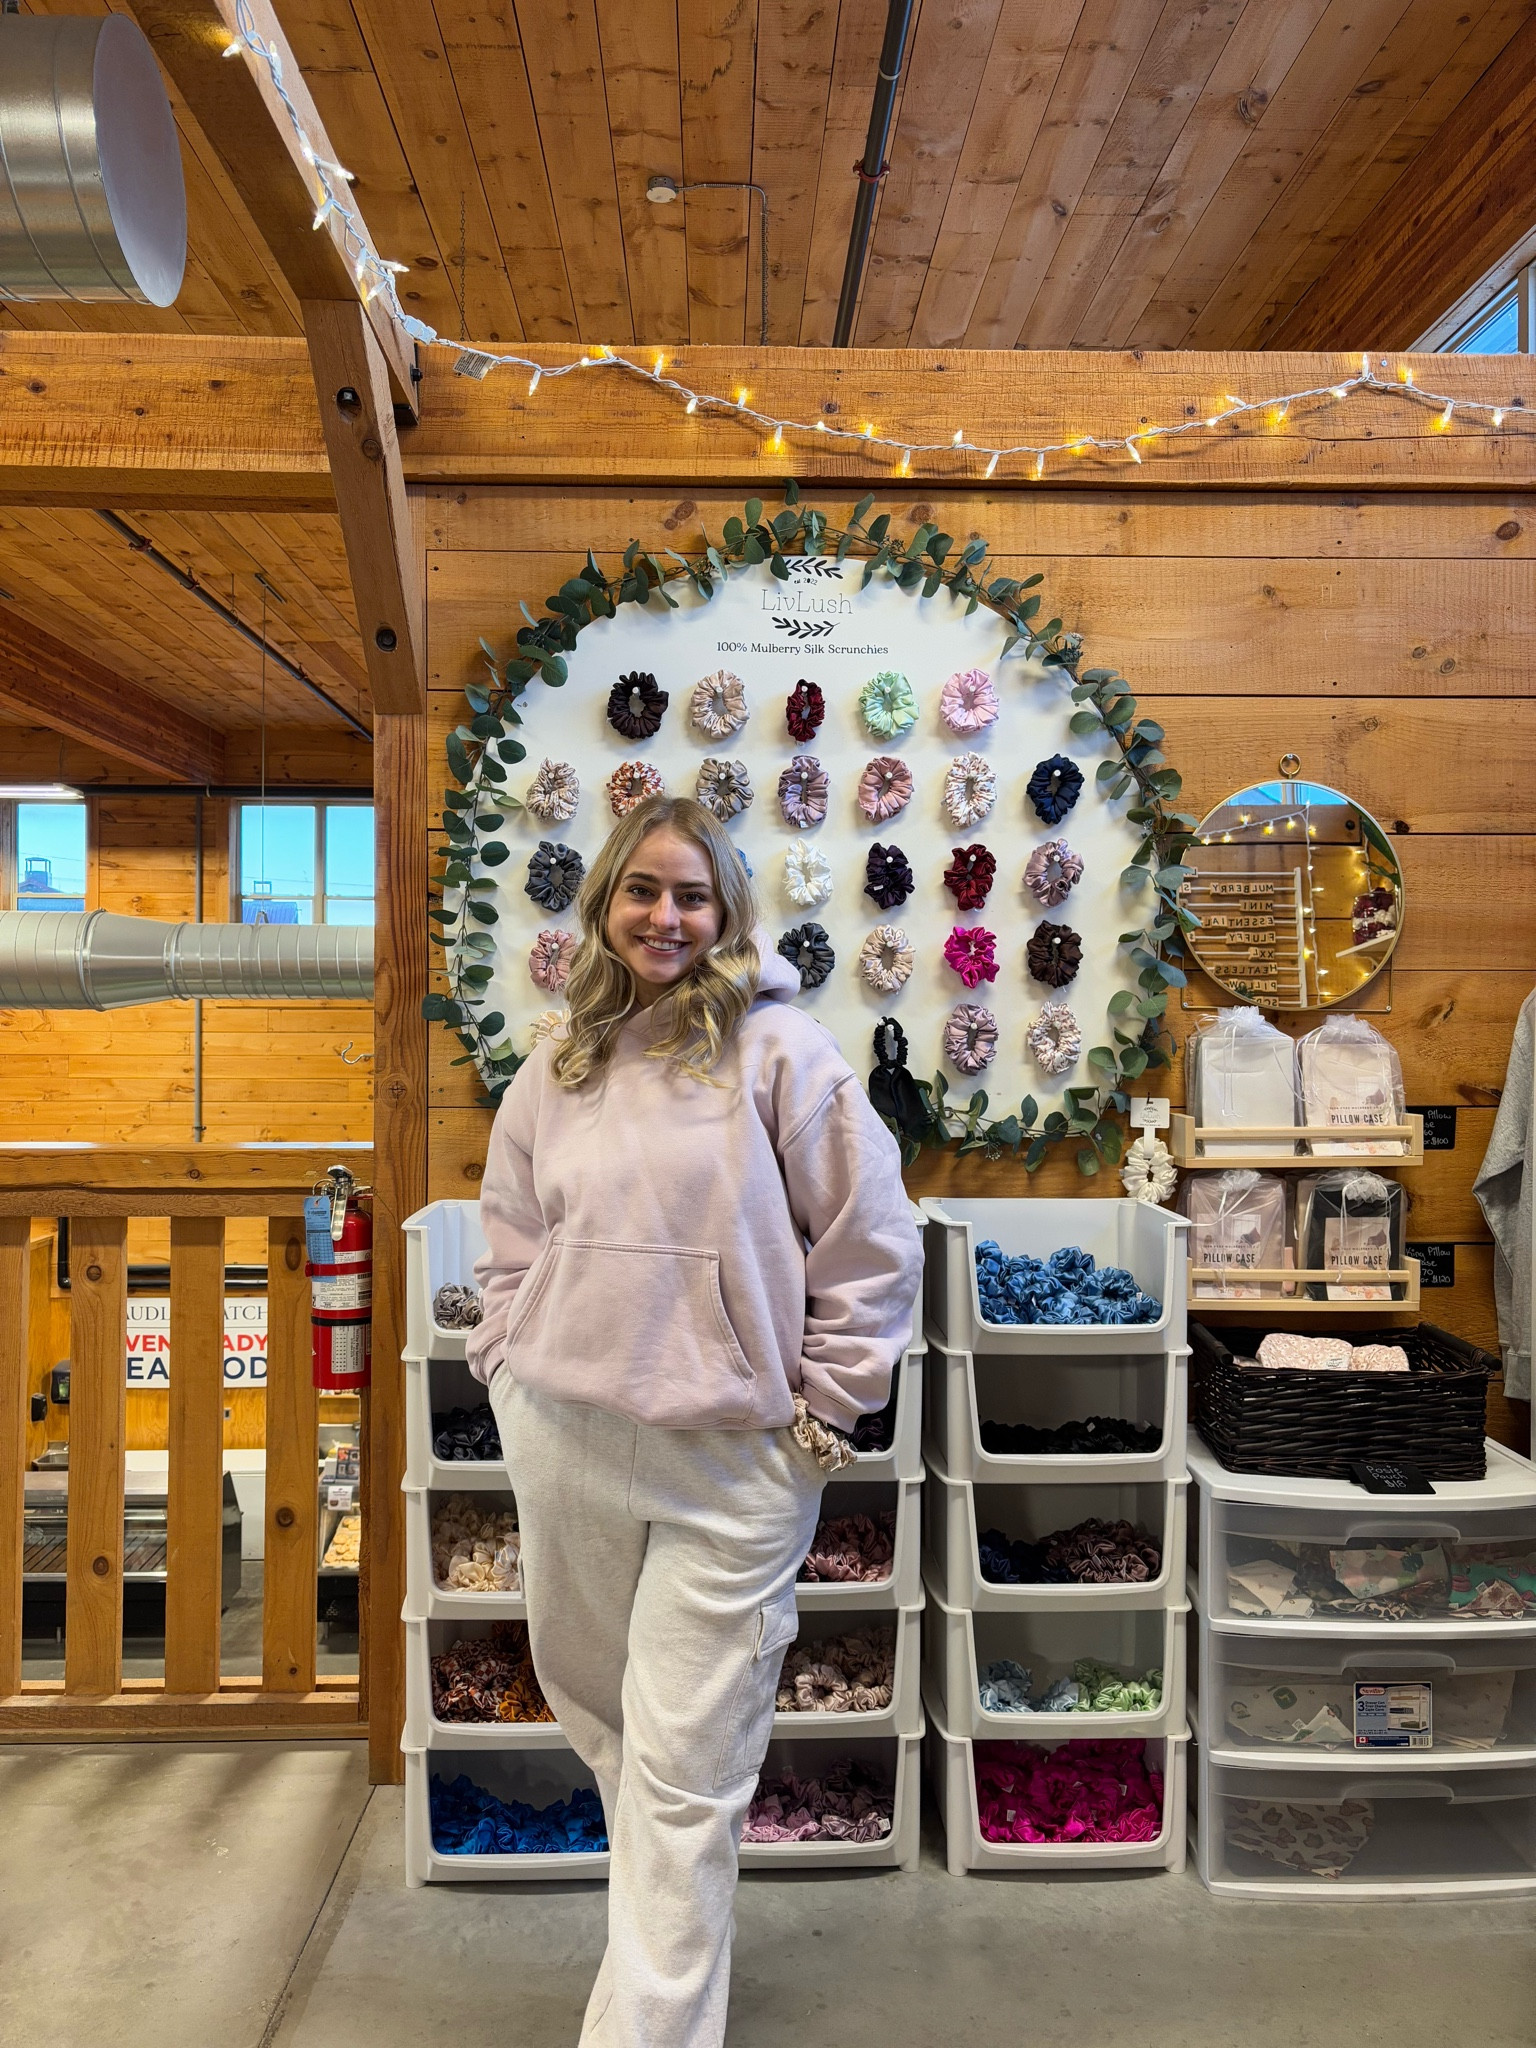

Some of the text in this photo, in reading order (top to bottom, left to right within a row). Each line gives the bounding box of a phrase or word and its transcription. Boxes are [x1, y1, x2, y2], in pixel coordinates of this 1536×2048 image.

[761, 589, 854, 614] LivLush
[716, 642, 889, 655] 100% Mulberry Silk Scrunchies
[1331, 1114, 1384, 1123] PILLOW CASE
[1428, 1109, 1452, 1119] Pillow
[1428, 1246, 1451, 1256] Pillow
[1203, 1254, 1255, 1263] PILLOW CASE
[1331, 1256, 1383, 1265] PILLOW CASE
[1358, 1701, 1364, 1711] 3
